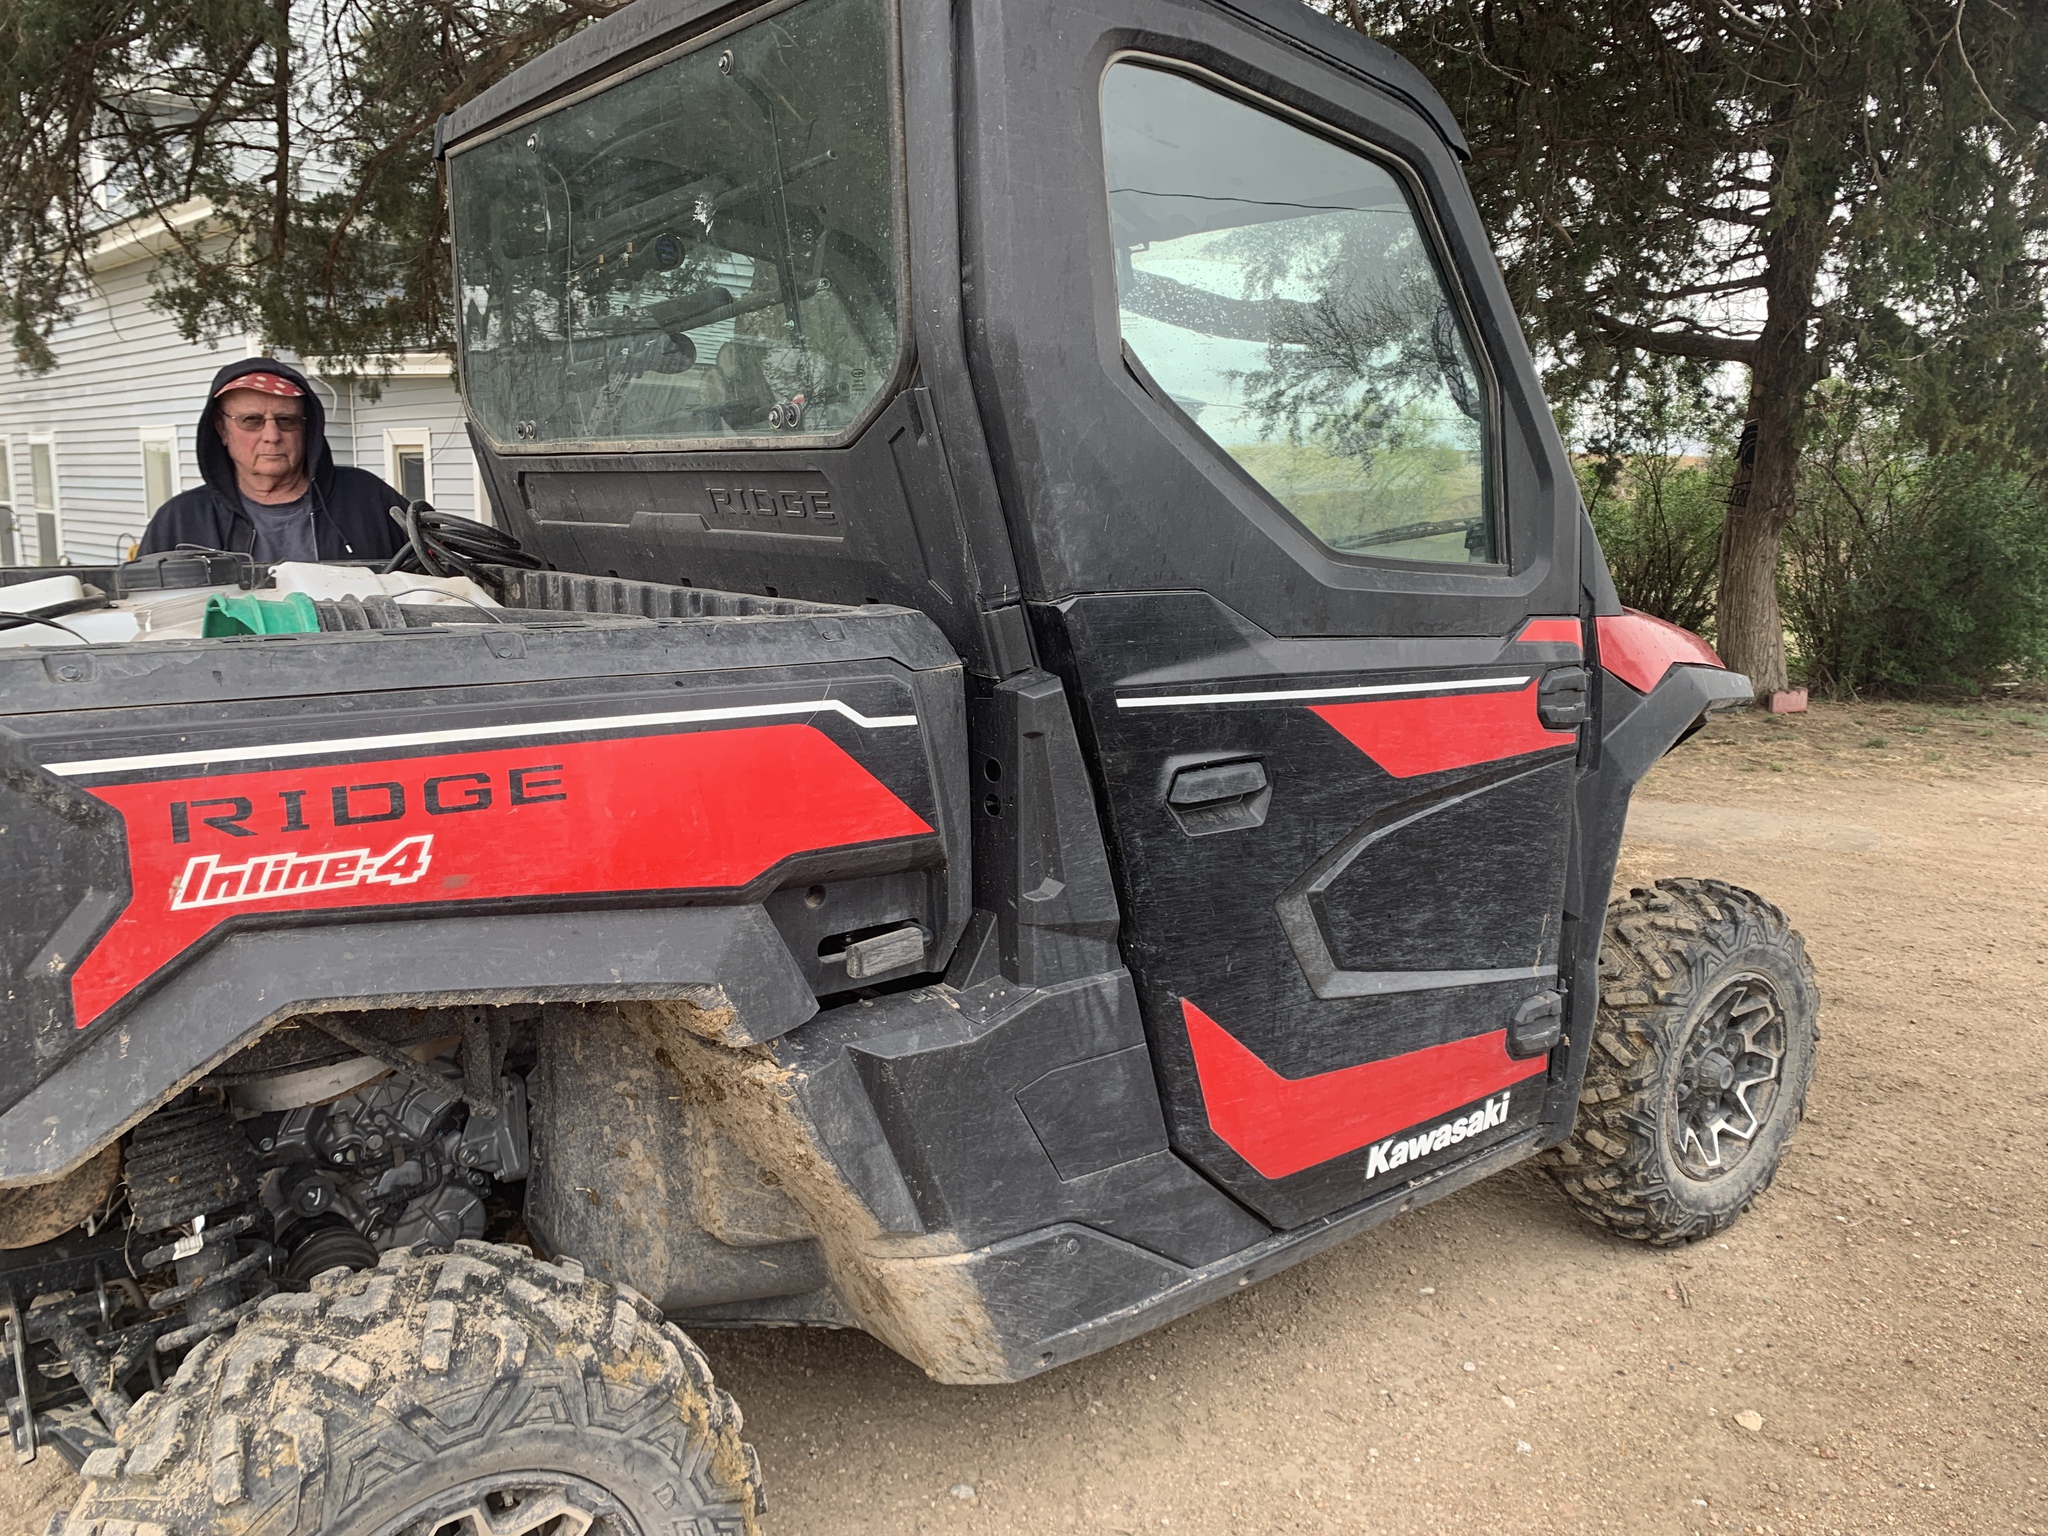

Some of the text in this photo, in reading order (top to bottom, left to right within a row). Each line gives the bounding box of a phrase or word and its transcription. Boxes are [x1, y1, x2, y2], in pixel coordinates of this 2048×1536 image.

[705, 487, 836, 520] RIDGE
[170, 764, 567, 844] RIDGE
[170, 833, 434, 911] Inline-4
[1366, 1091, 1510, 1180] Kawasaki
